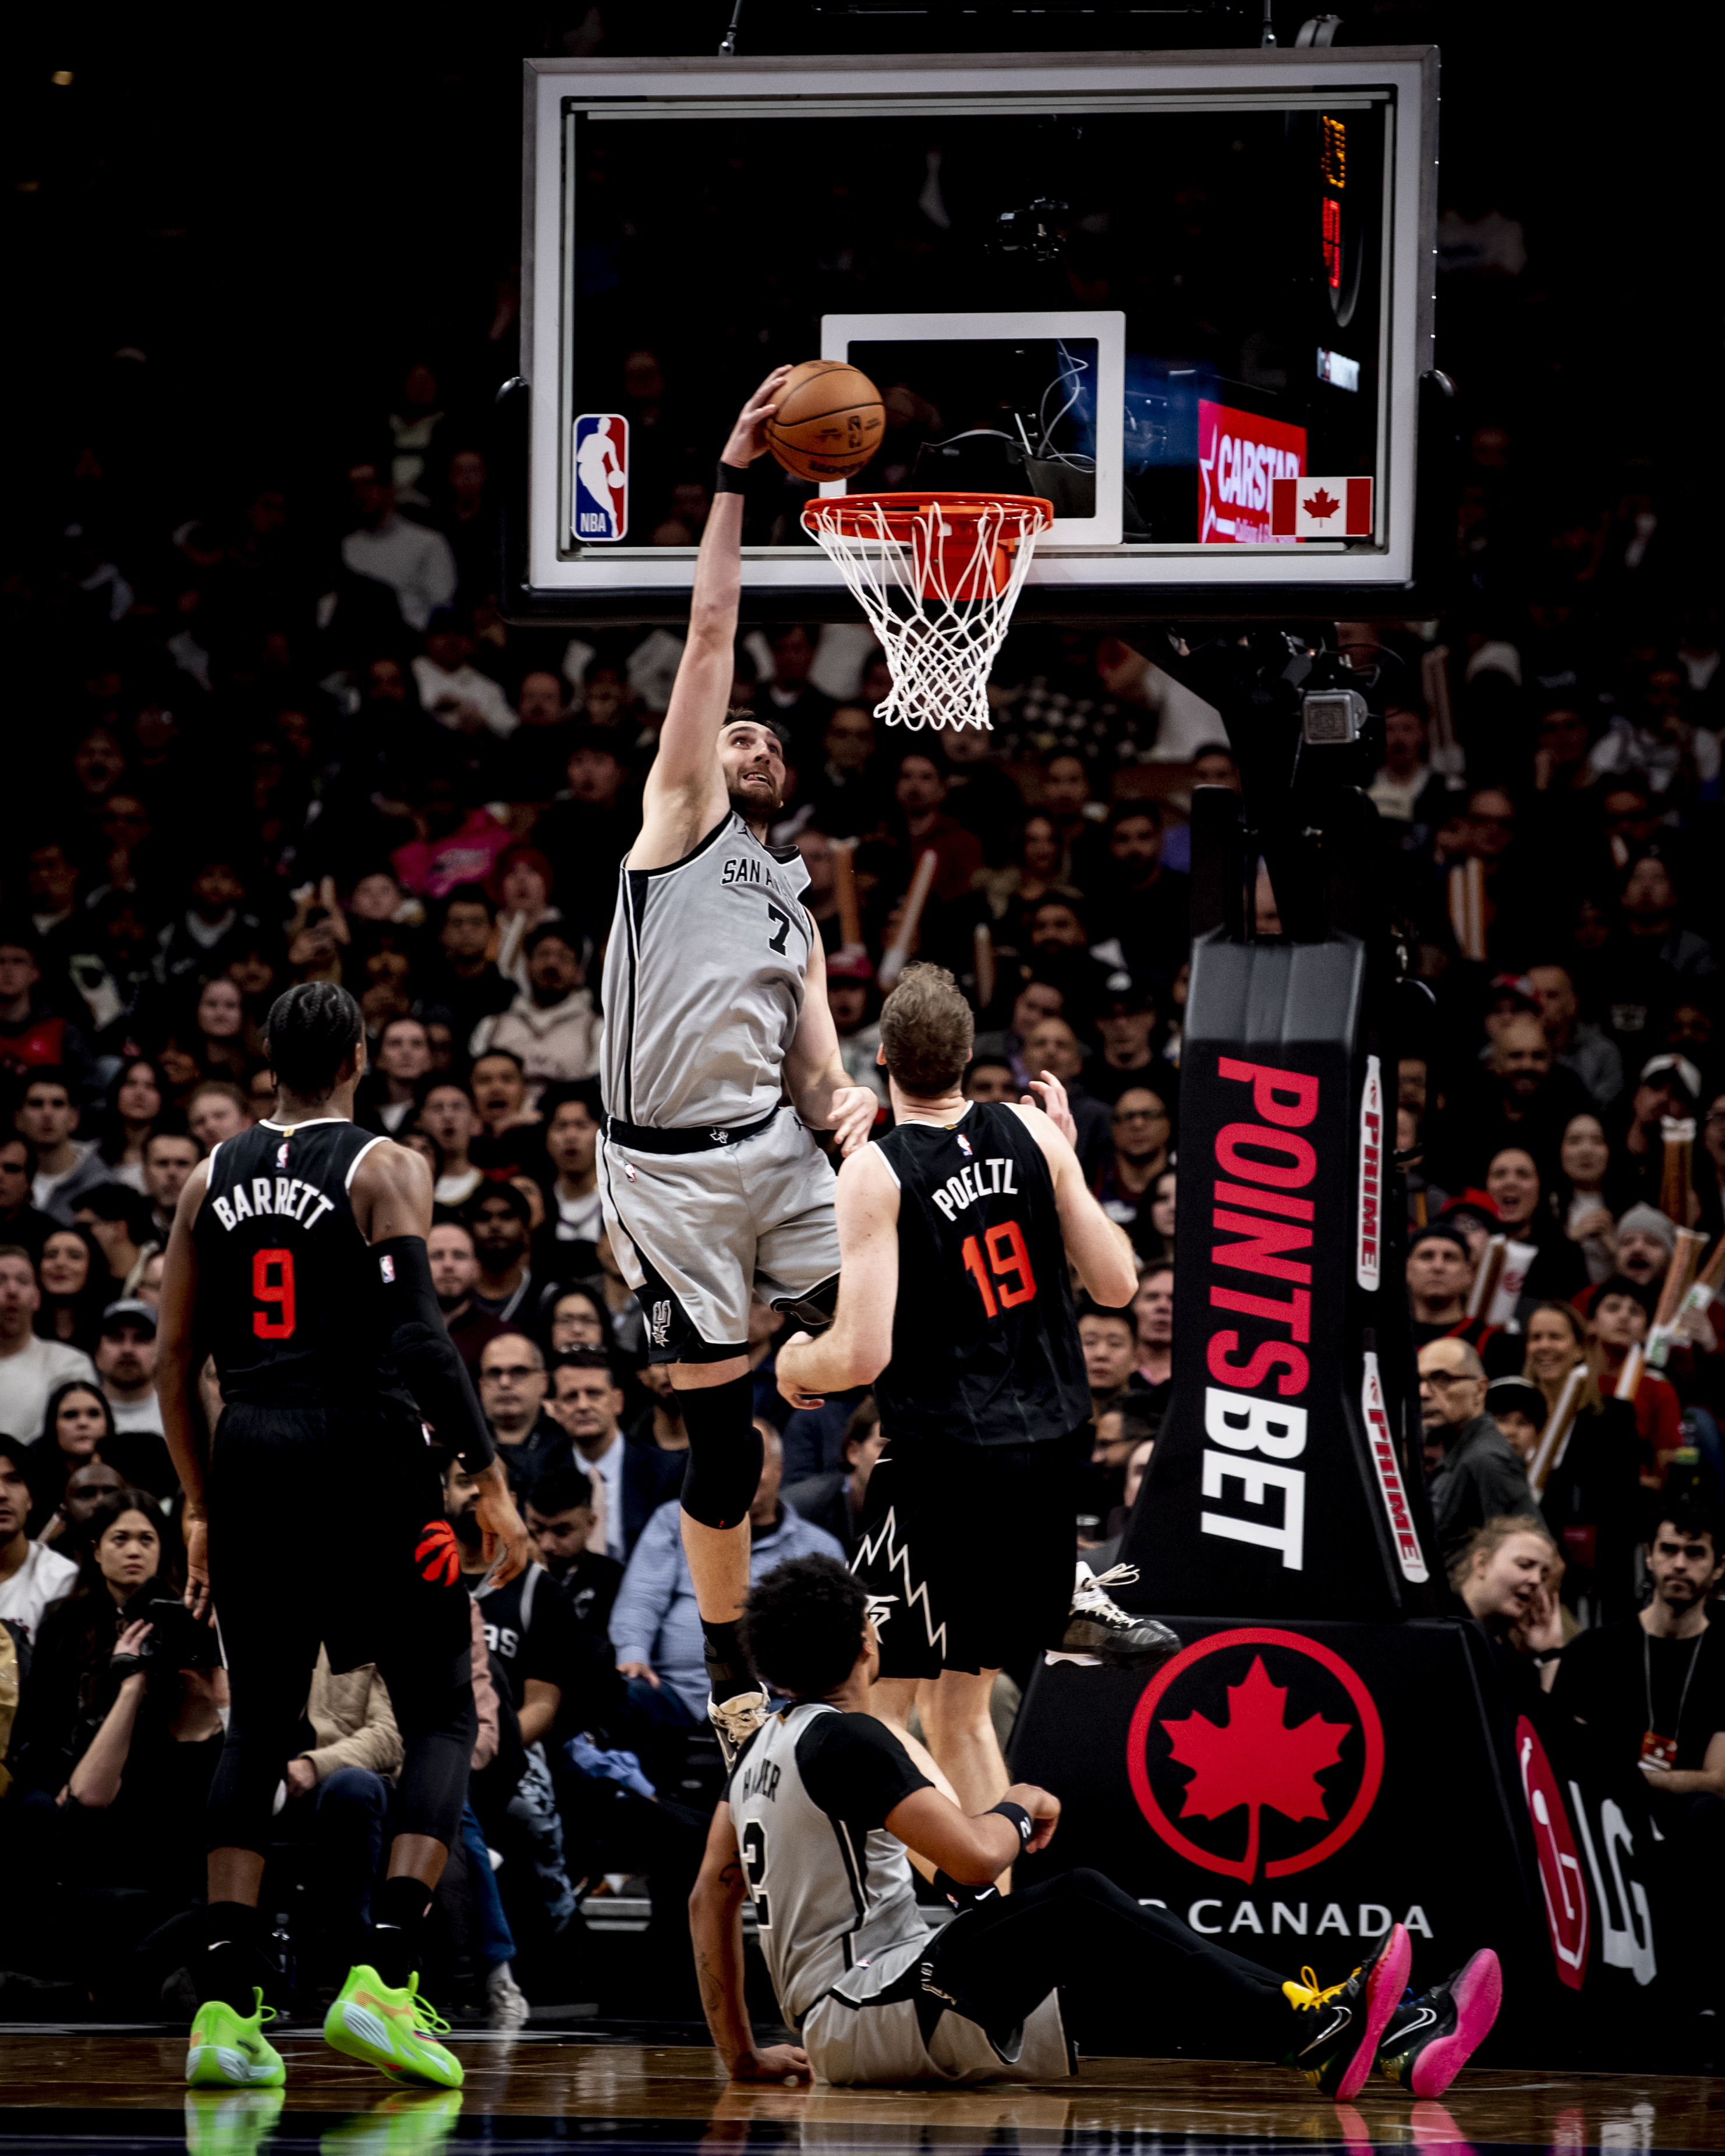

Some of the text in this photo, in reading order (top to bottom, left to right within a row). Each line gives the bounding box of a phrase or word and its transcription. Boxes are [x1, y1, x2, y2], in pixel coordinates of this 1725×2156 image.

[580, 512, 607, 532] NBA
[721, 858, 760, 885] SAN
[767, 902, 791, 957] 7
[212, 1177, 335, 1232] BARRETT
[931, 1158, 1018, 1221] POELTL
[1361, 1111, 1380, 1269] PRIME
[252, 1248, 296, 1340] 9
[961, 1220, 1037, 1318] 19
[1200, 1056, 1319, 1571] POINTSBET
[1368, 1409, 1421, 1560] PRIME
[741, 1818, 772, 1929] 2
[1188, 1899, 1433, 1938] CANADA
